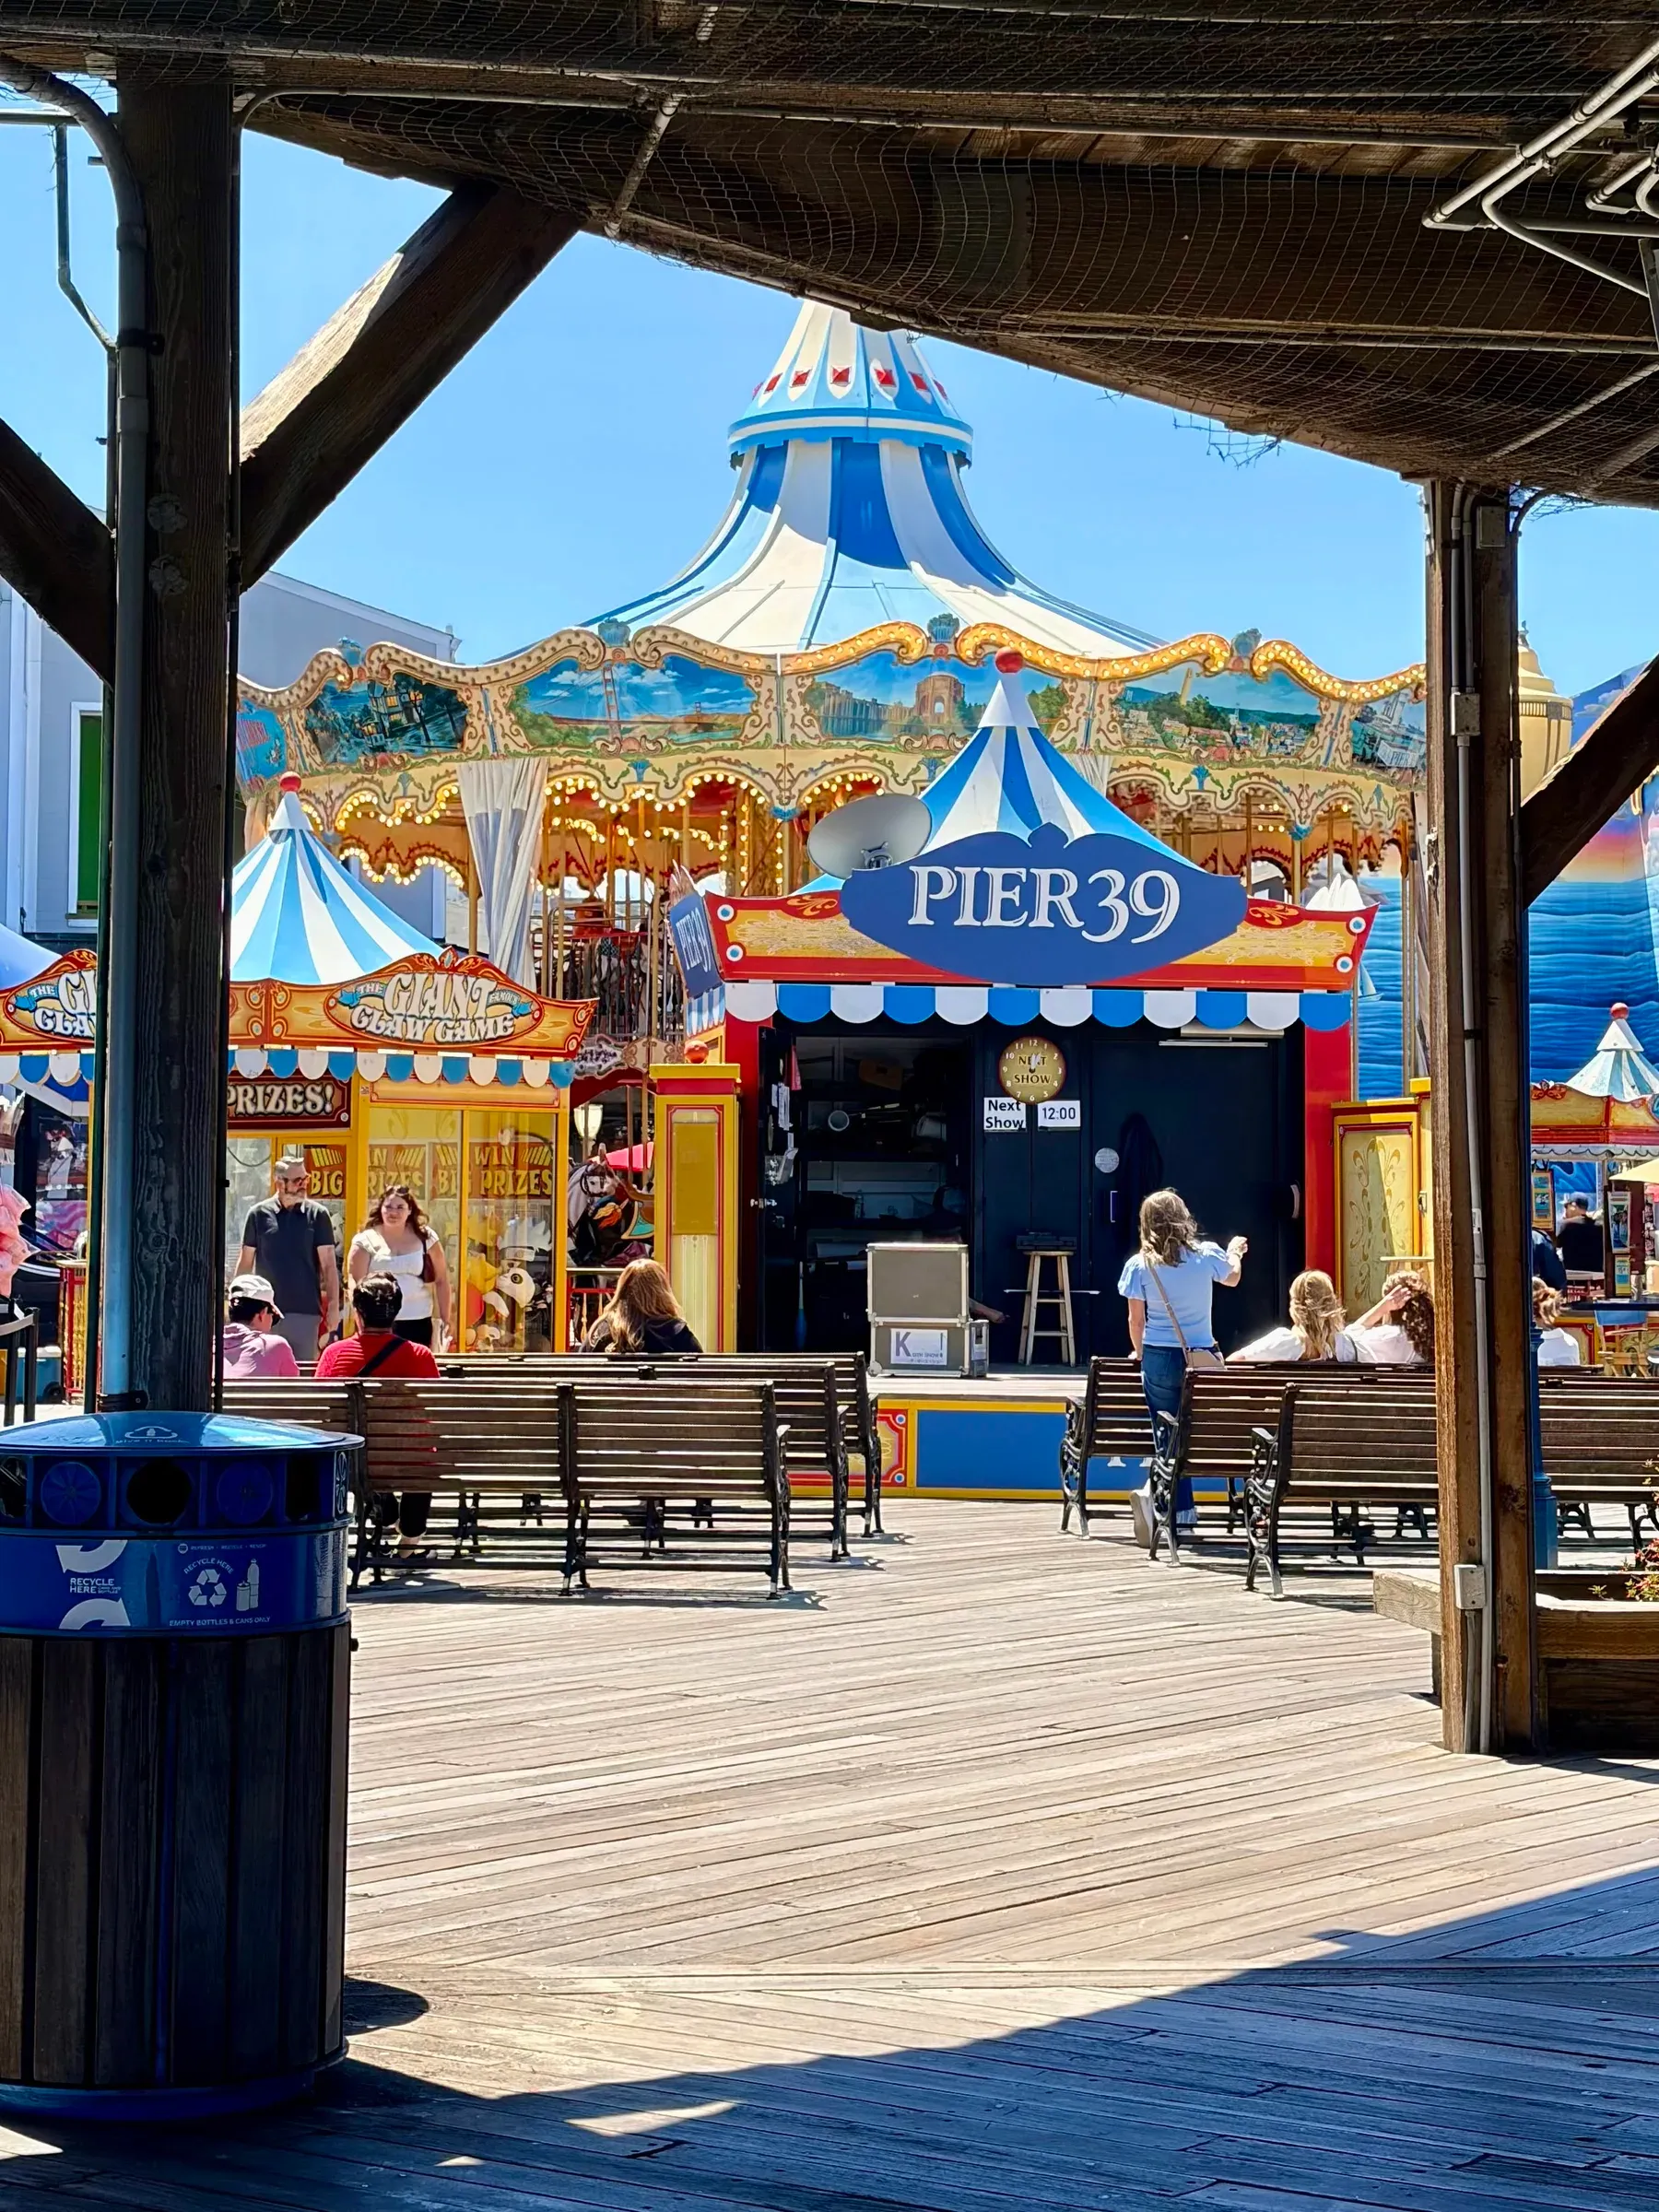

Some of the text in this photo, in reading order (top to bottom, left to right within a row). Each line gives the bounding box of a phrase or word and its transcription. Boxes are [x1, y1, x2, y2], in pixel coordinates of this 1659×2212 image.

[907, 865, 1181, 944] PIER 39
[29, 984, 55, 998] THE
[357, 983, 383, 995] THE
[383, 972, 499, 1018] GIANT
[35, 1007, 96, 1039] CLA
[351, 1006, 514, 1042] CLAW GAME
[1014, 1074, 1051, 1084] SHOW
[988, 1100, 1021, 1112] Next
[1042, 1107, 1077, 1120] 12:00
[985, 1116, 1025, 1128] Show
[475, 1146, 515, 1166] WIN
[310, 1171, 343, 1196] BIG
[438, 1169, 552, 1196] BI PRIZES
[896, 1332, 912, 1357] K
[183, 1558, 234, 1574] RECYCLE HERE
[69, 1585, 97, 1594] HERE
[70, 1577, 115, 1586] RECYCLE
